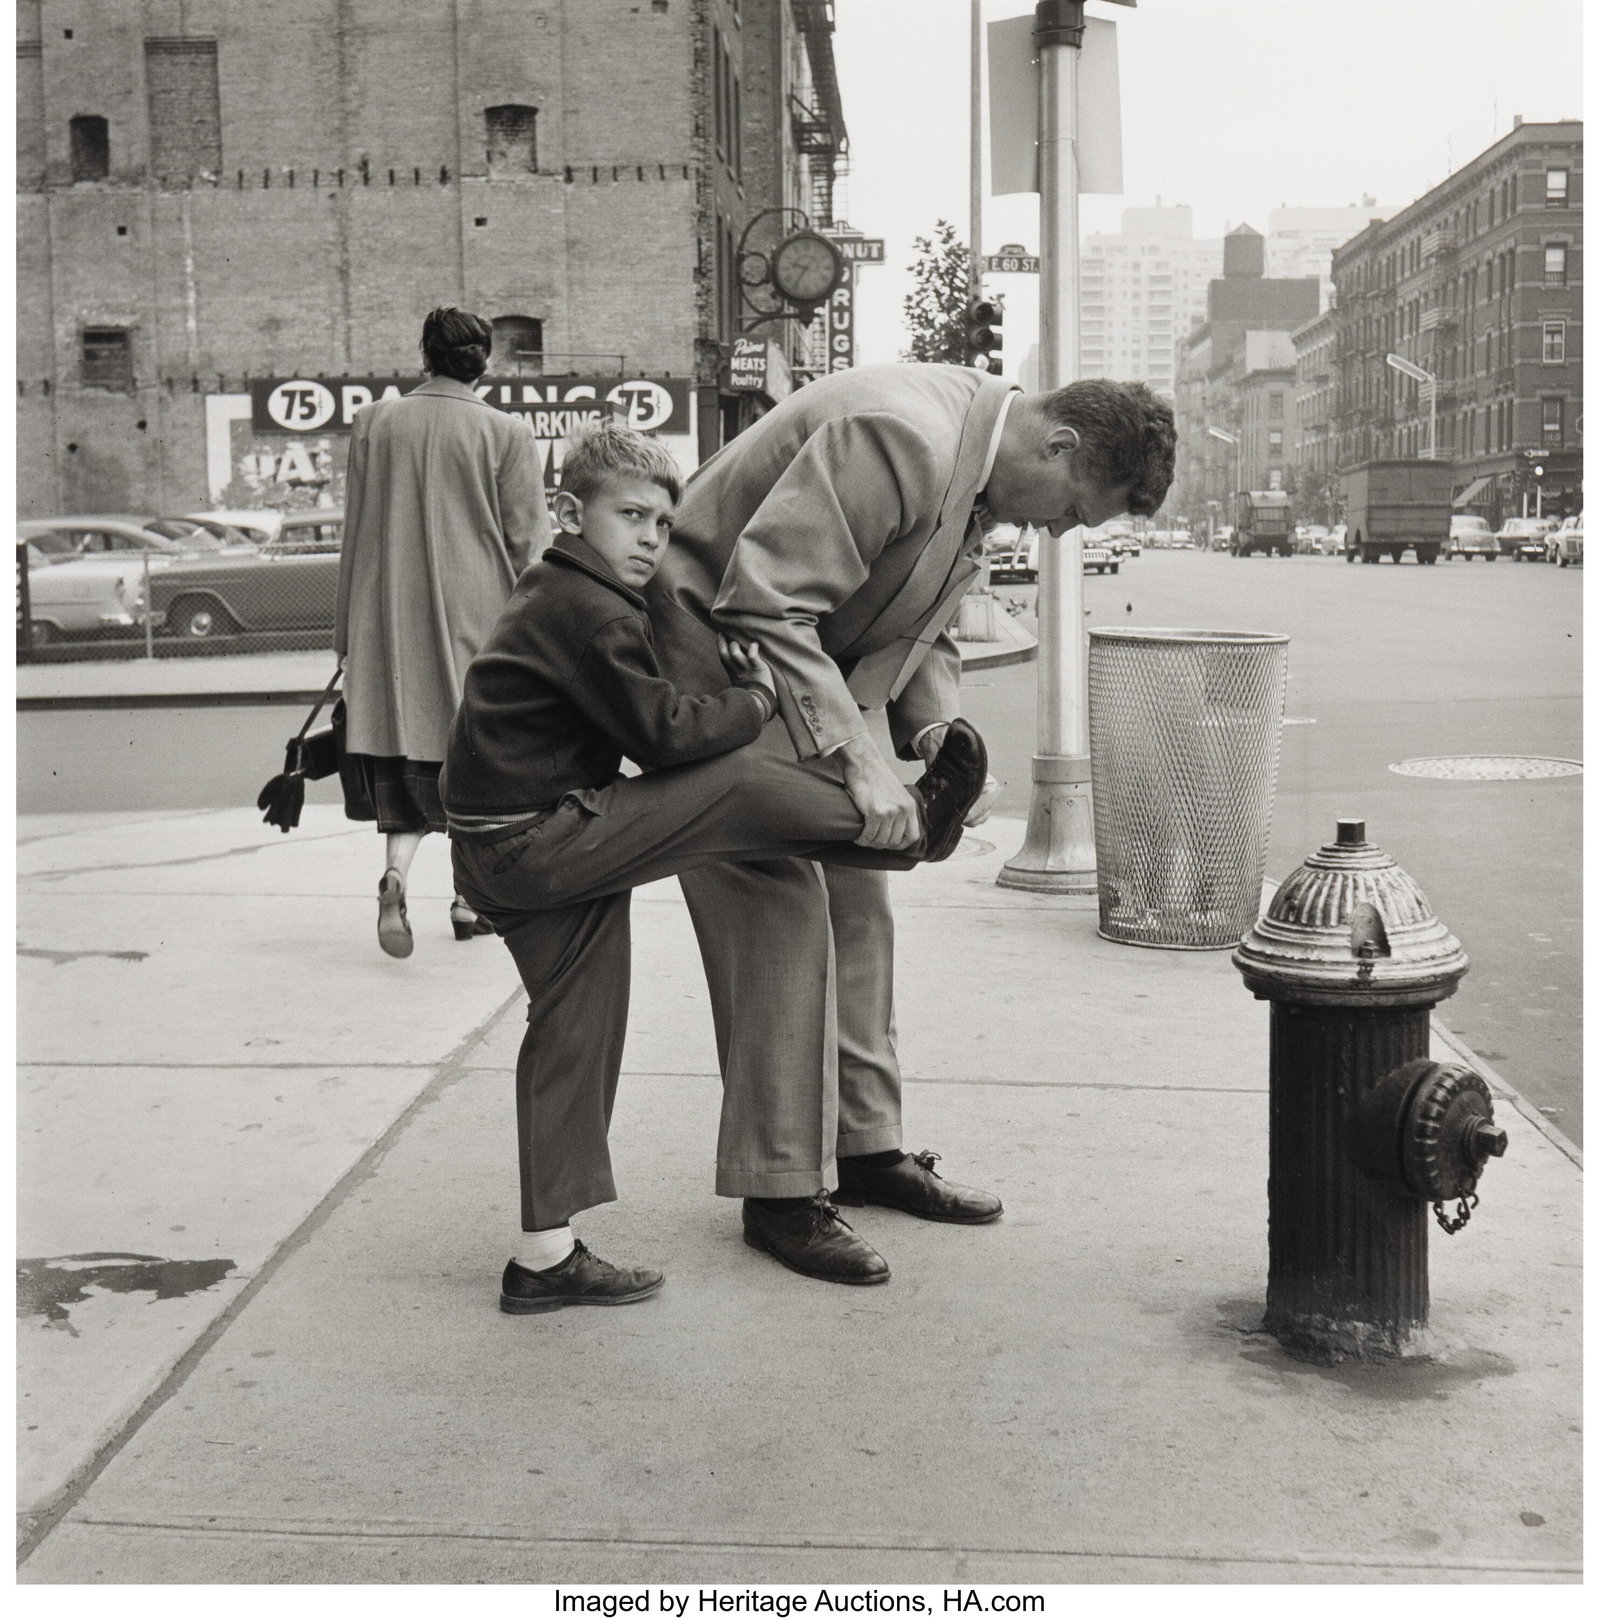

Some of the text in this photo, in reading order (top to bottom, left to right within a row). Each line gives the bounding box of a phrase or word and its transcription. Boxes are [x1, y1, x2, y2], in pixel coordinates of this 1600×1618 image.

[1002, 258, 1019, 271] 60
[734, 338, 765, 356] Prime
[731, 357, 766, 371] MEATS
[731, 373, 764, 388] Poultry
[342, 386, 596, 424] PING
